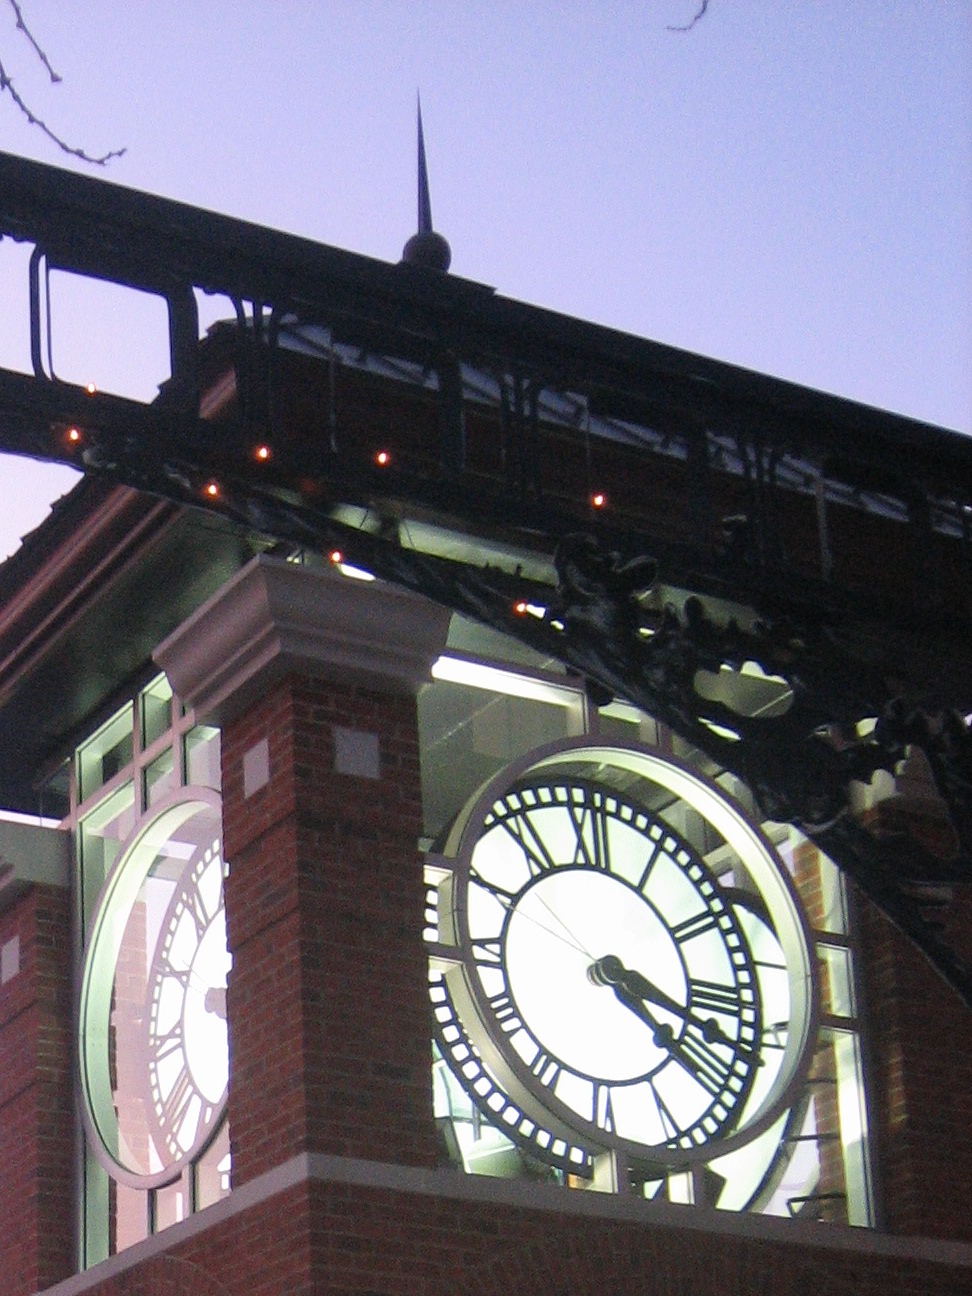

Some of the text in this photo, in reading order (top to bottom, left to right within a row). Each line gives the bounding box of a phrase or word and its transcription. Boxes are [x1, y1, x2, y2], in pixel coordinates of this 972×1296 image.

[498, 809, 555, 878] XI
[566, 803, 611, 872] XII
[671, 908, 718, 945] II
[688, 978, 742, 1018] III
